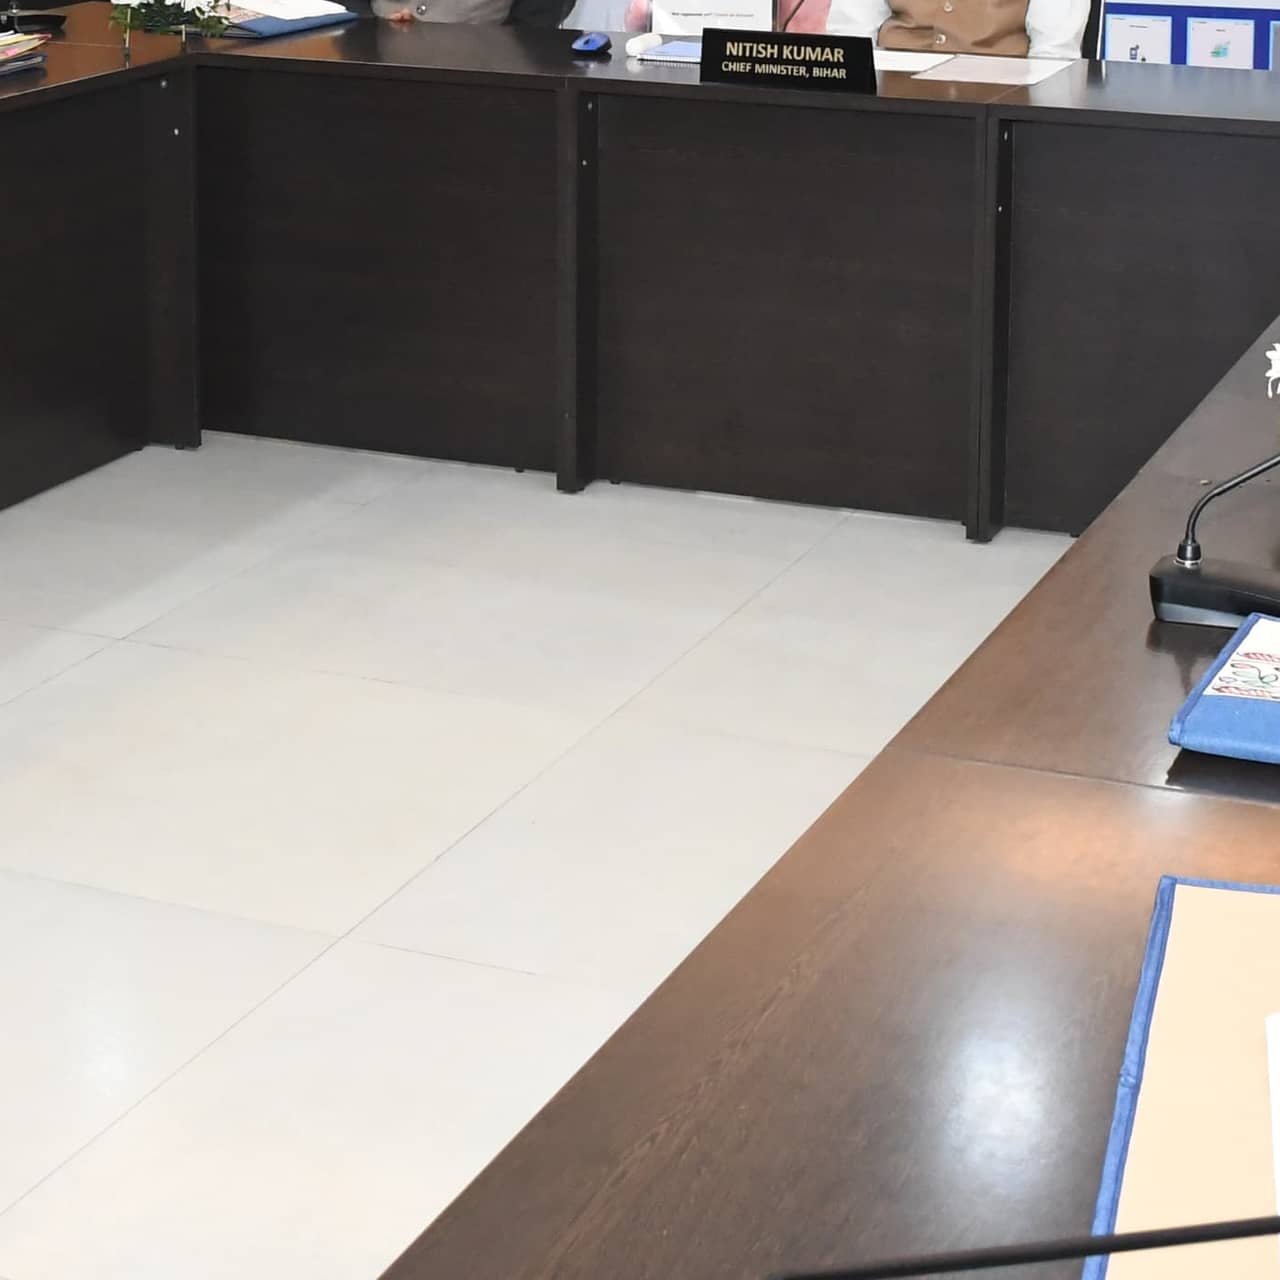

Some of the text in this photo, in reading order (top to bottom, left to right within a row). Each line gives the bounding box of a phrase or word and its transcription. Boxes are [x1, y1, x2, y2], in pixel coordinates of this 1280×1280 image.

[725, 41, 844, 63] NITISH KUMAR
[721, 61, 847, 79] CHIEF MINISTER, BIHAR
